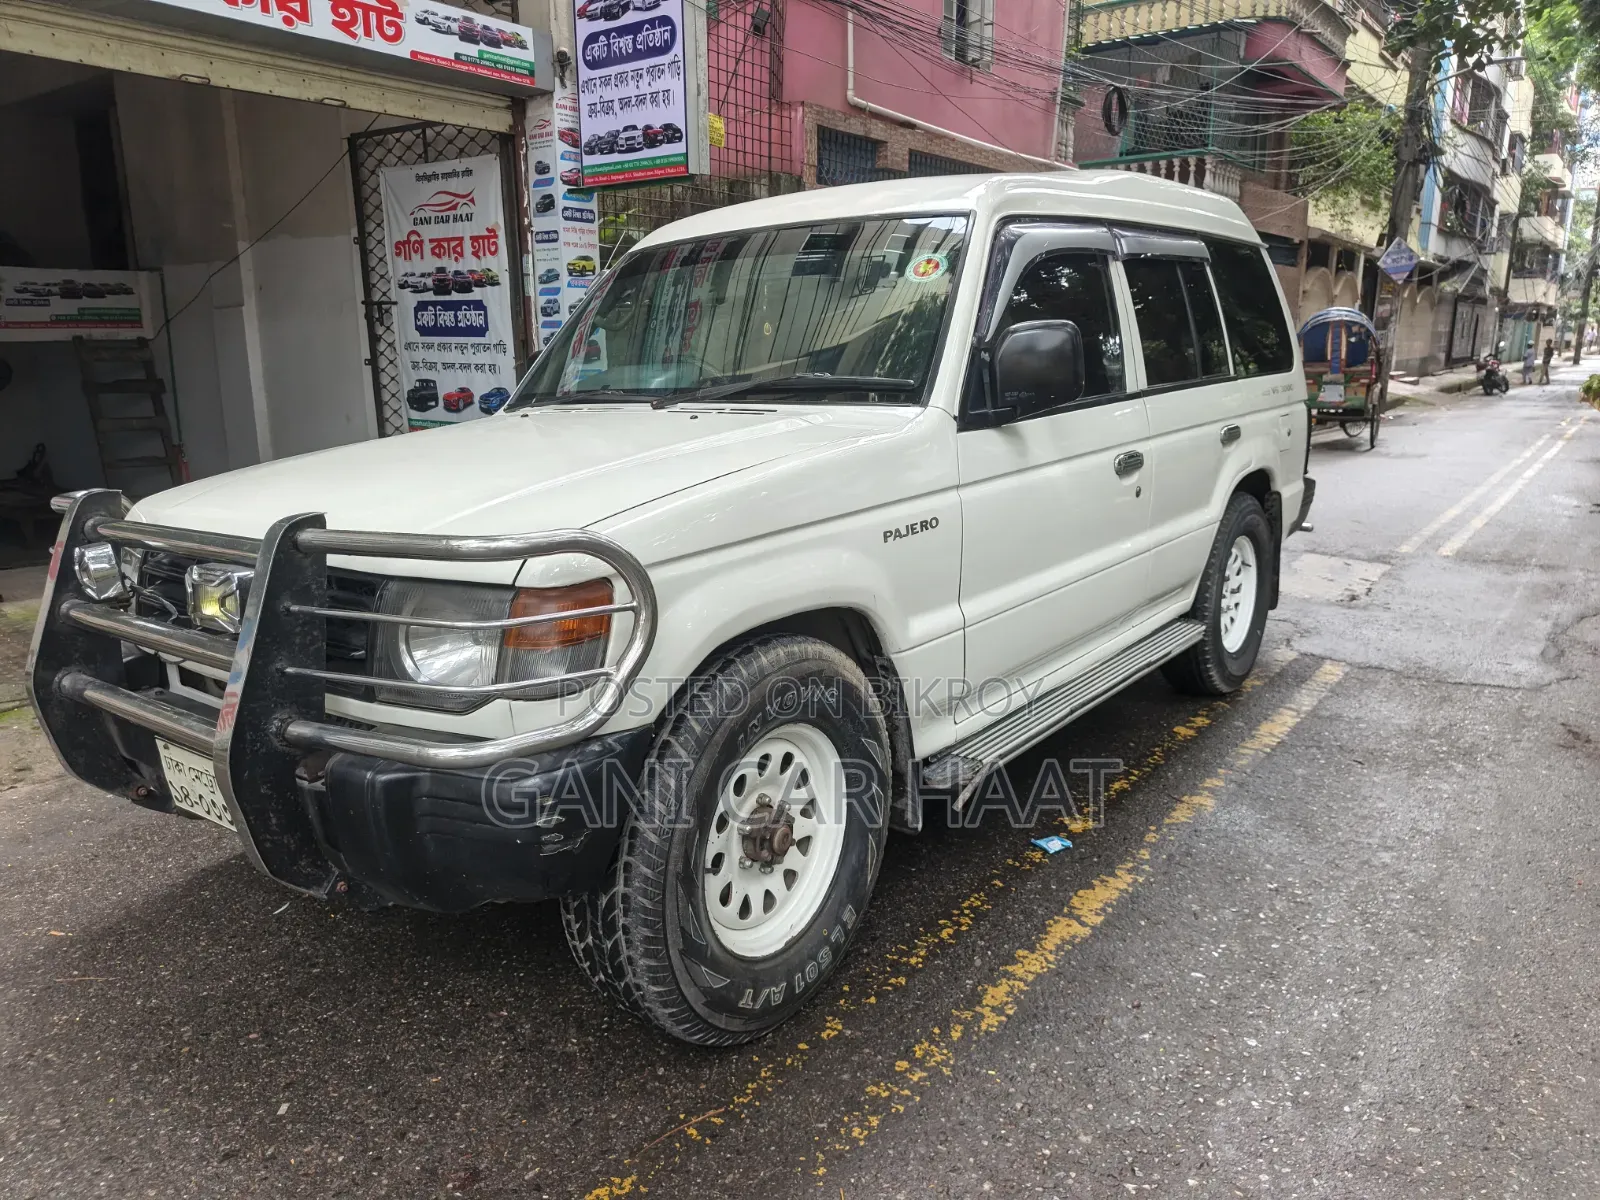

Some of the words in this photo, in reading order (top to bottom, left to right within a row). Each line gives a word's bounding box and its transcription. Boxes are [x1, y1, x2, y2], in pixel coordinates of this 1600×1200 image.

[328, 0, 406, 45] হাট
[585, 34, 608, 63] একটি
[609, 31, 634, 59] বিশ্বস্ত
[636, 20, 672, 53] প্রতিষ্ঠান
[580, 76, 597, 96] এখানে
[598, 73, 613, 92] সকল
[613, 70, 629, 89] প্রকার
[630, 67, 644, 90] নতুন
[648, 90, 661, 109] করা
[413, 216, 432, 227] GANI
[434, 215, 450, 225] CAR
[453, 212, 474, 223] HAAT
[394, 229, 424, 262] গণি
[429, 236, 464, 264] কার
[470, 227, 499, 260] হাট
[416, 306, 435, 327] একটি
[436, 305, 455, 327] বিশ্বস্ত
[457, 305, 485, 328] প্রতিষ্ঠান
[404, 342, 419, 352] এখানে
[421, 342, 435, 353] সকল
[437, 342, 452, 353] প্রকার
[454, 342, 468, 355] নতুন
[474, 363, 487, 374] করা
[883, 516, 940, 544] PAJERO
[164, 755, 187, 777] ঢাকা
[738, 981, 788, 1010] A/T
